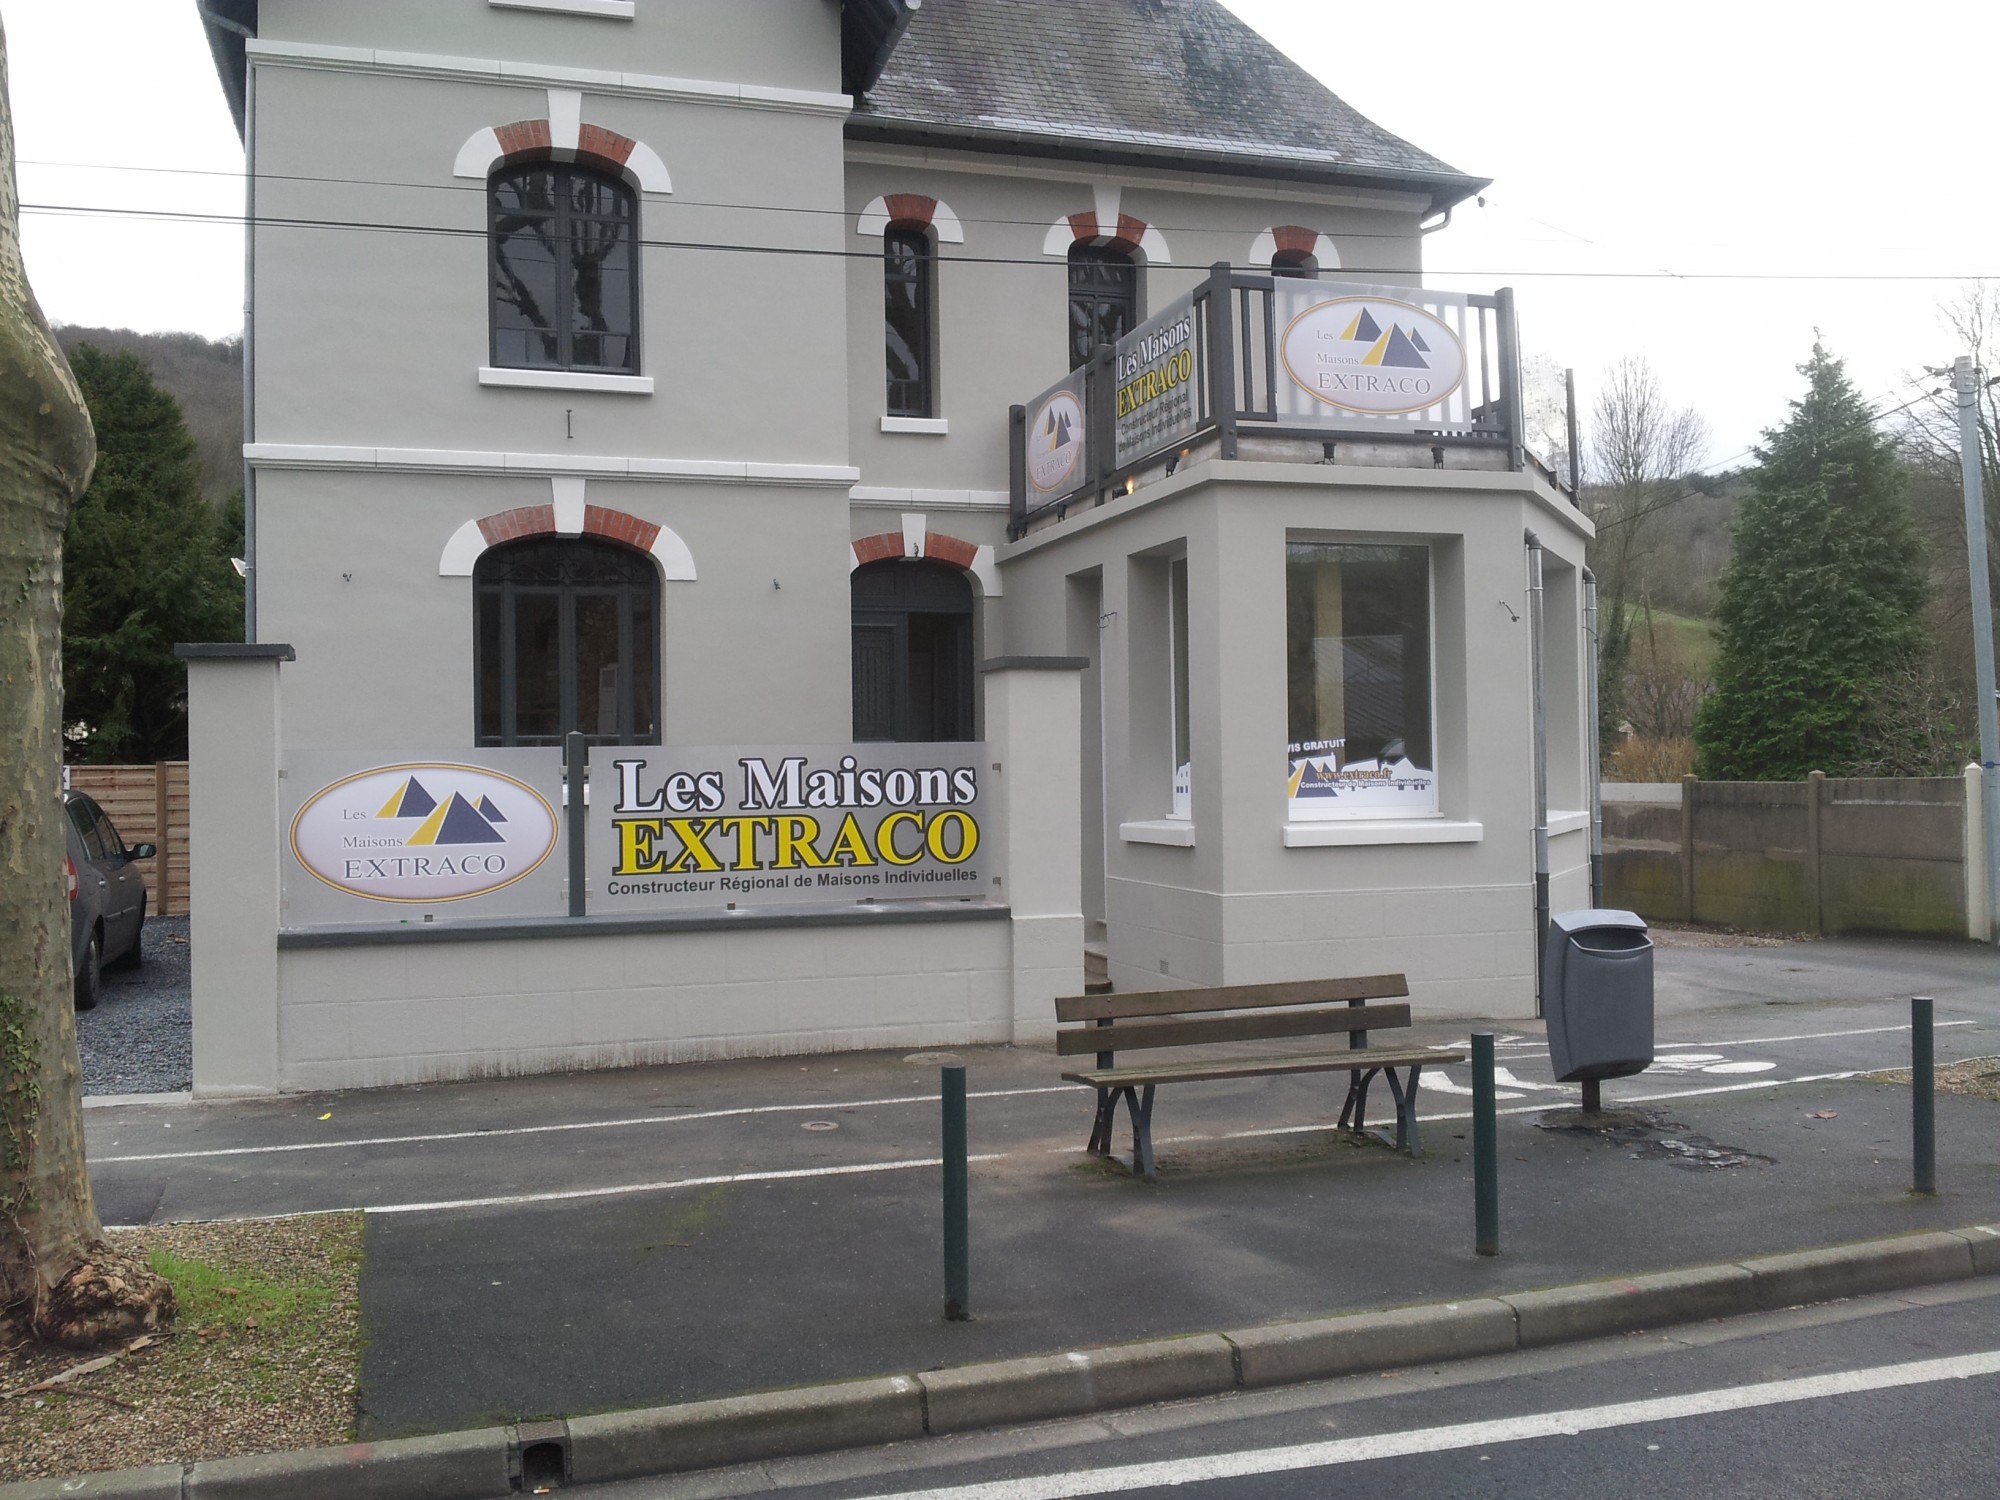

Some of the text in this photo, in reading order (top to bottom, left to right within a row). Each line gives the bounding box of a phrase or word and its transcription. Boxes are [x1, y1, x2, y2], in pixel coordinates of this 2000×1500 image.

[1316, 329, 1334, 340] Les
[1118, 316, 1191, 382] Les Maisons
[1316, 352, 1360, 366] Maisons
[1117, 348, 1192, 419] EXTRACO
[1318, 372, 1431, 395] EXTRACO
[1036, 450, 1072, 480] EXTRACO
[1303, 738, 1346, 752] GRATUIT
[613, 755, 978, 813] Les Maisons
[1300, 780, 1346, 789] Constructeur
[1358, 779, 1387, 788] Maisons
[1388, 777, 1431, 786] Individuelles
[1316, 767, 1393, 780] www.extraco.fr
[343, 809, 367, 820] Les
[343, 835, 403, 849] Maisons
[612, 809, 980, 876] EXTRACO
[344, 854, 507, 880] EXTRACO
[607, 868, 978, 896] Constructeur Régional de Maisons Individuelles
